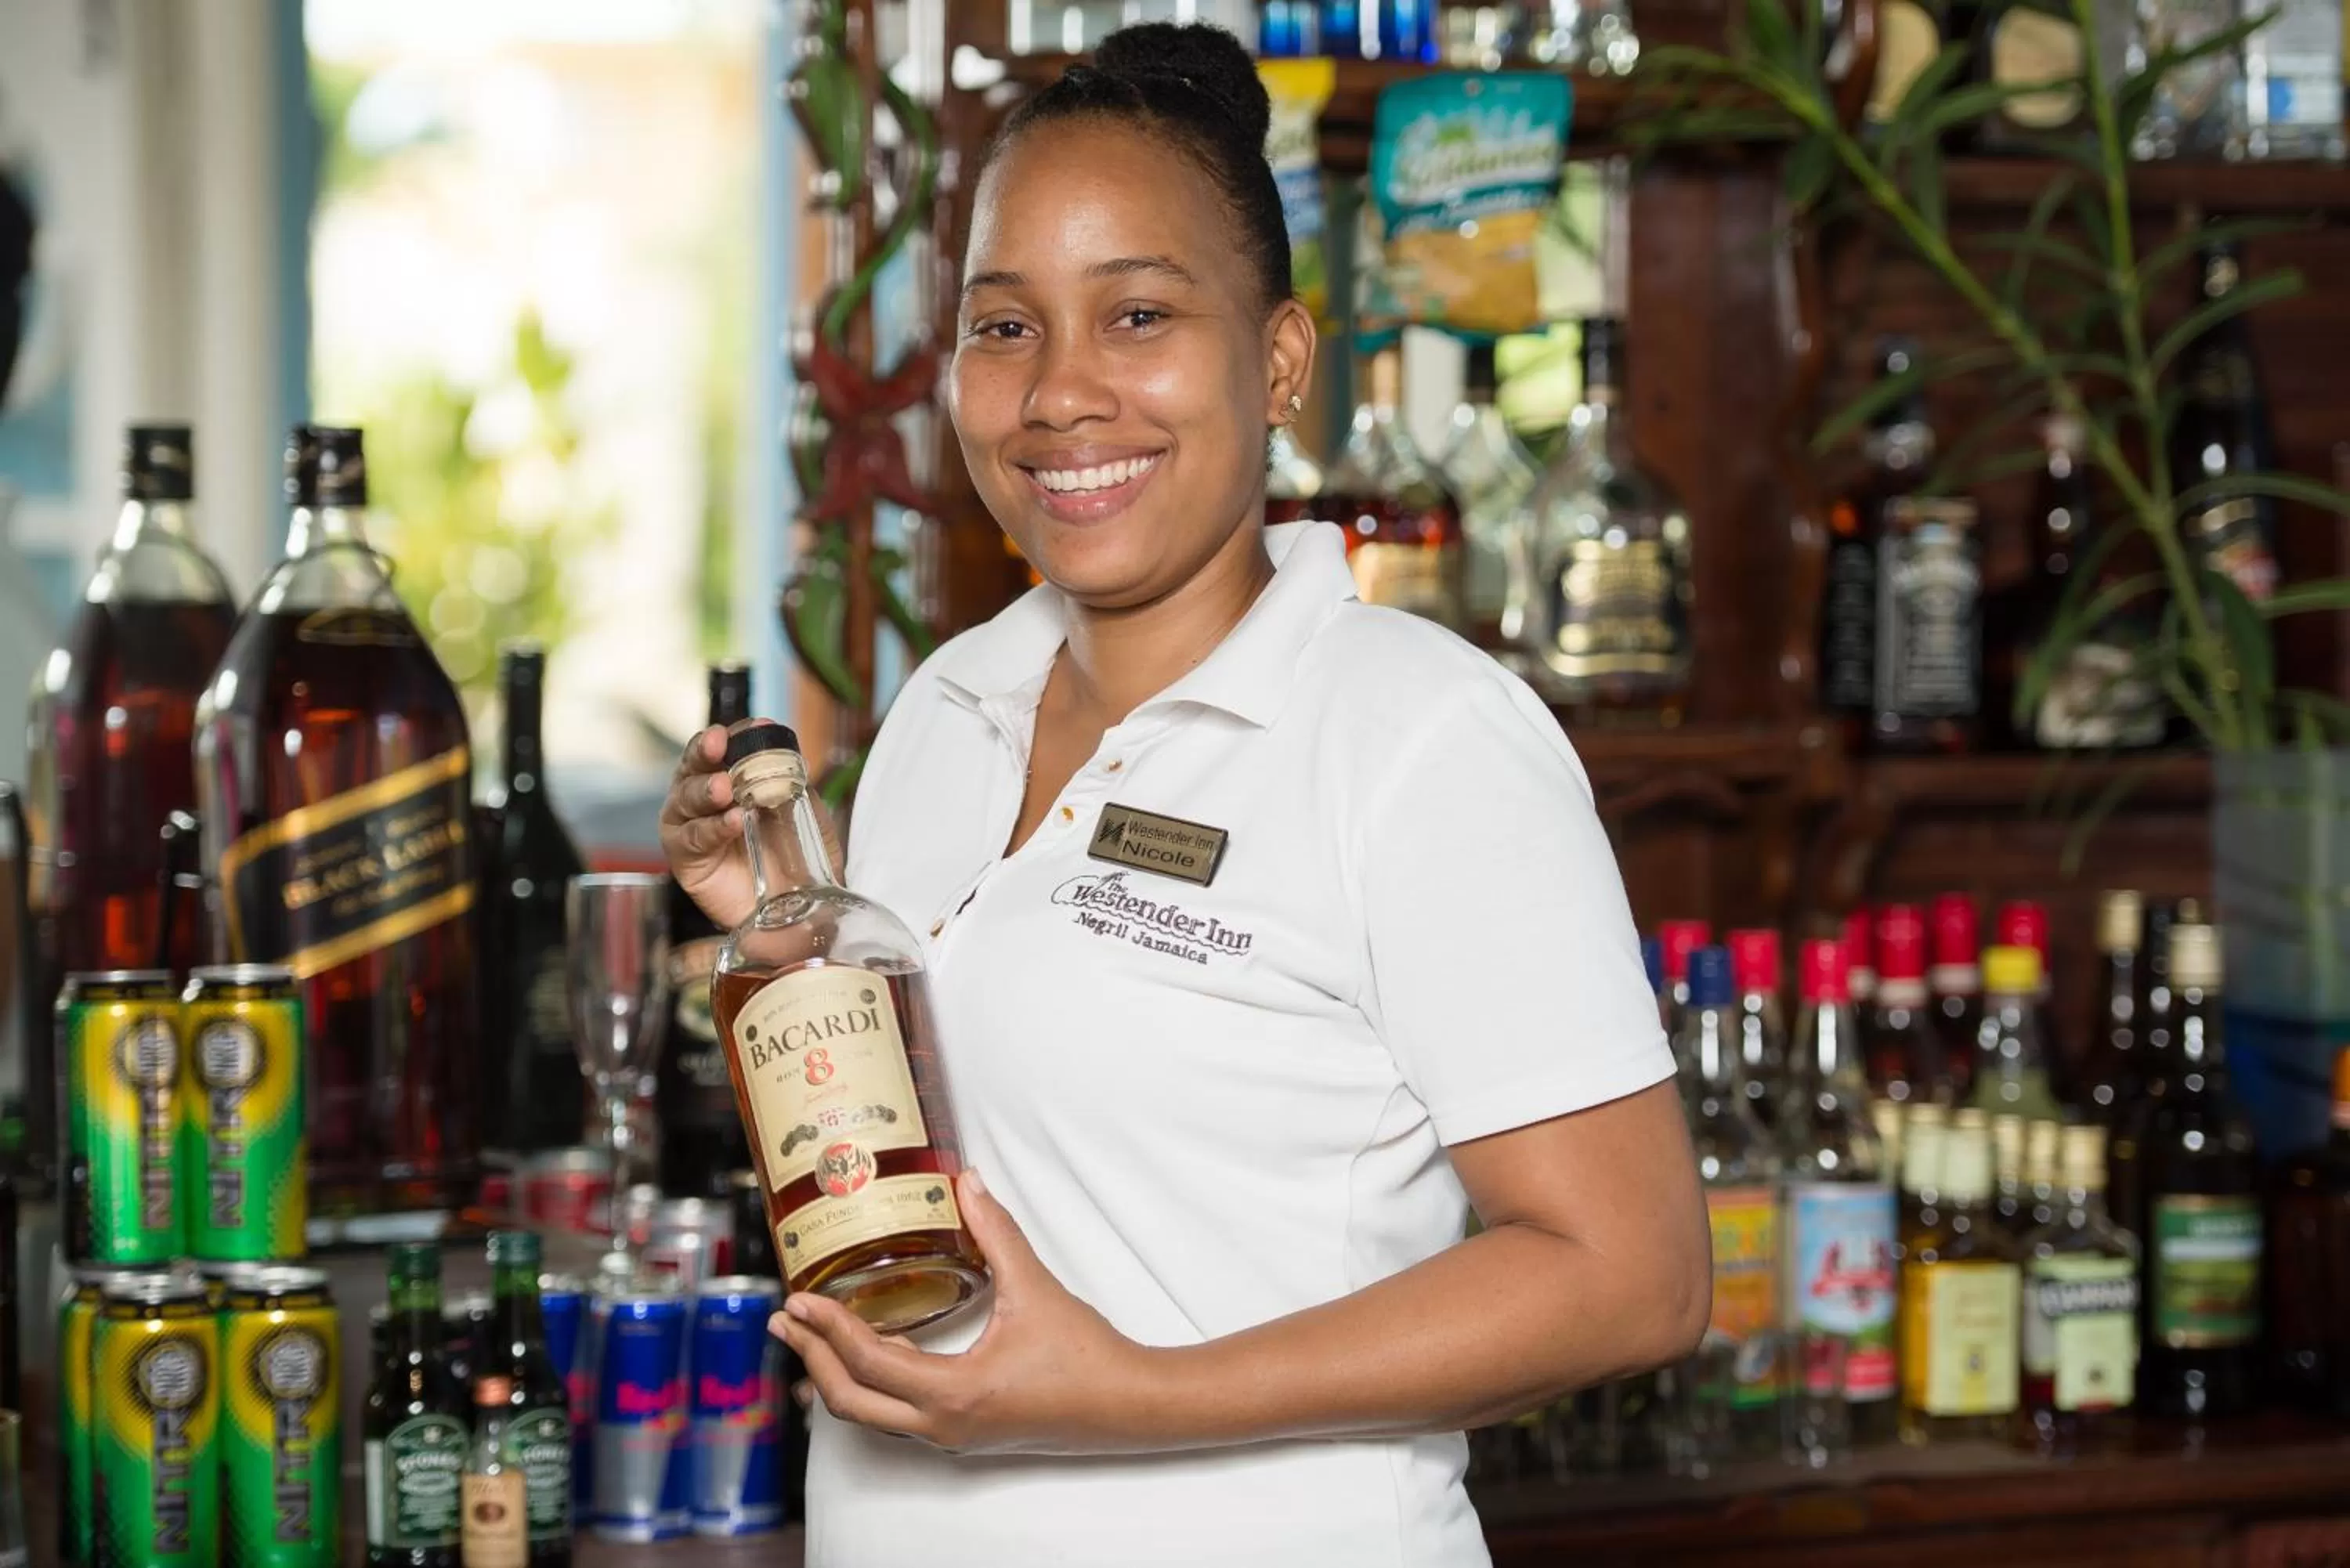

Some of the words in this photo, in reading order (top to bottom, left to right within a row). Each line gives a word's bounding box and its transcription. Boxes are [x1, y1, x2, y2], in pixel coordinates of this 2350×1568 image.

[1121, 840, 1196, 868] Nicole
[1126, 820, 1193, 848] Westender
[1193, 836, 1215, 850] Inn
[1076, 911, 1130, 940] Negril
[1131, 930, 1209, 965] Jamaica
[750, 1007, 883, 1070] BACARDI
[803, 1047, 835, 1086] 8
